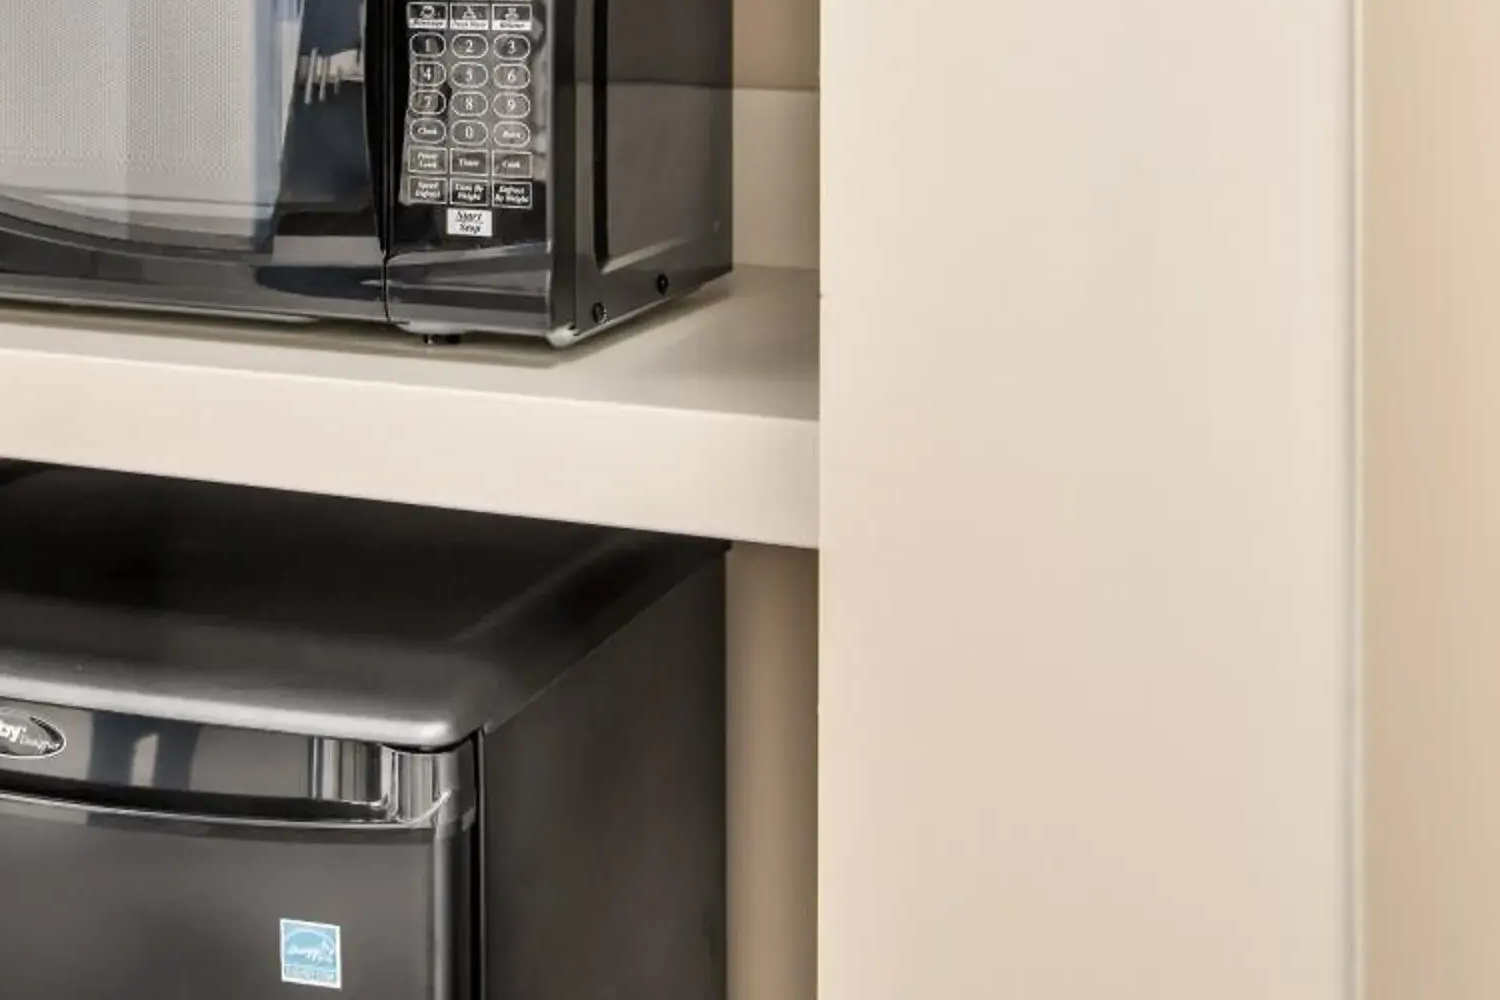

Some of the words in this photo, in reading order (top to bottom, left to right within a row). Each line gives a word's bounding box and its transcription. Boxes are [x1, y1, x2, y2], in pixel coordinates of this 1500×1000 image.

[464, 39, 476, 53] 2
[507, 39, 517, 55] 3
[423, 66, 433, 81] 4
[464, 67, 474, 82] 5
[507, 68, 517, 83] 6
[423, 94, 434, 109] 7
[464, 96, 474, 111] 8
[506, 98, 517, 112] 9
[464, 125, 474, 140] 0
